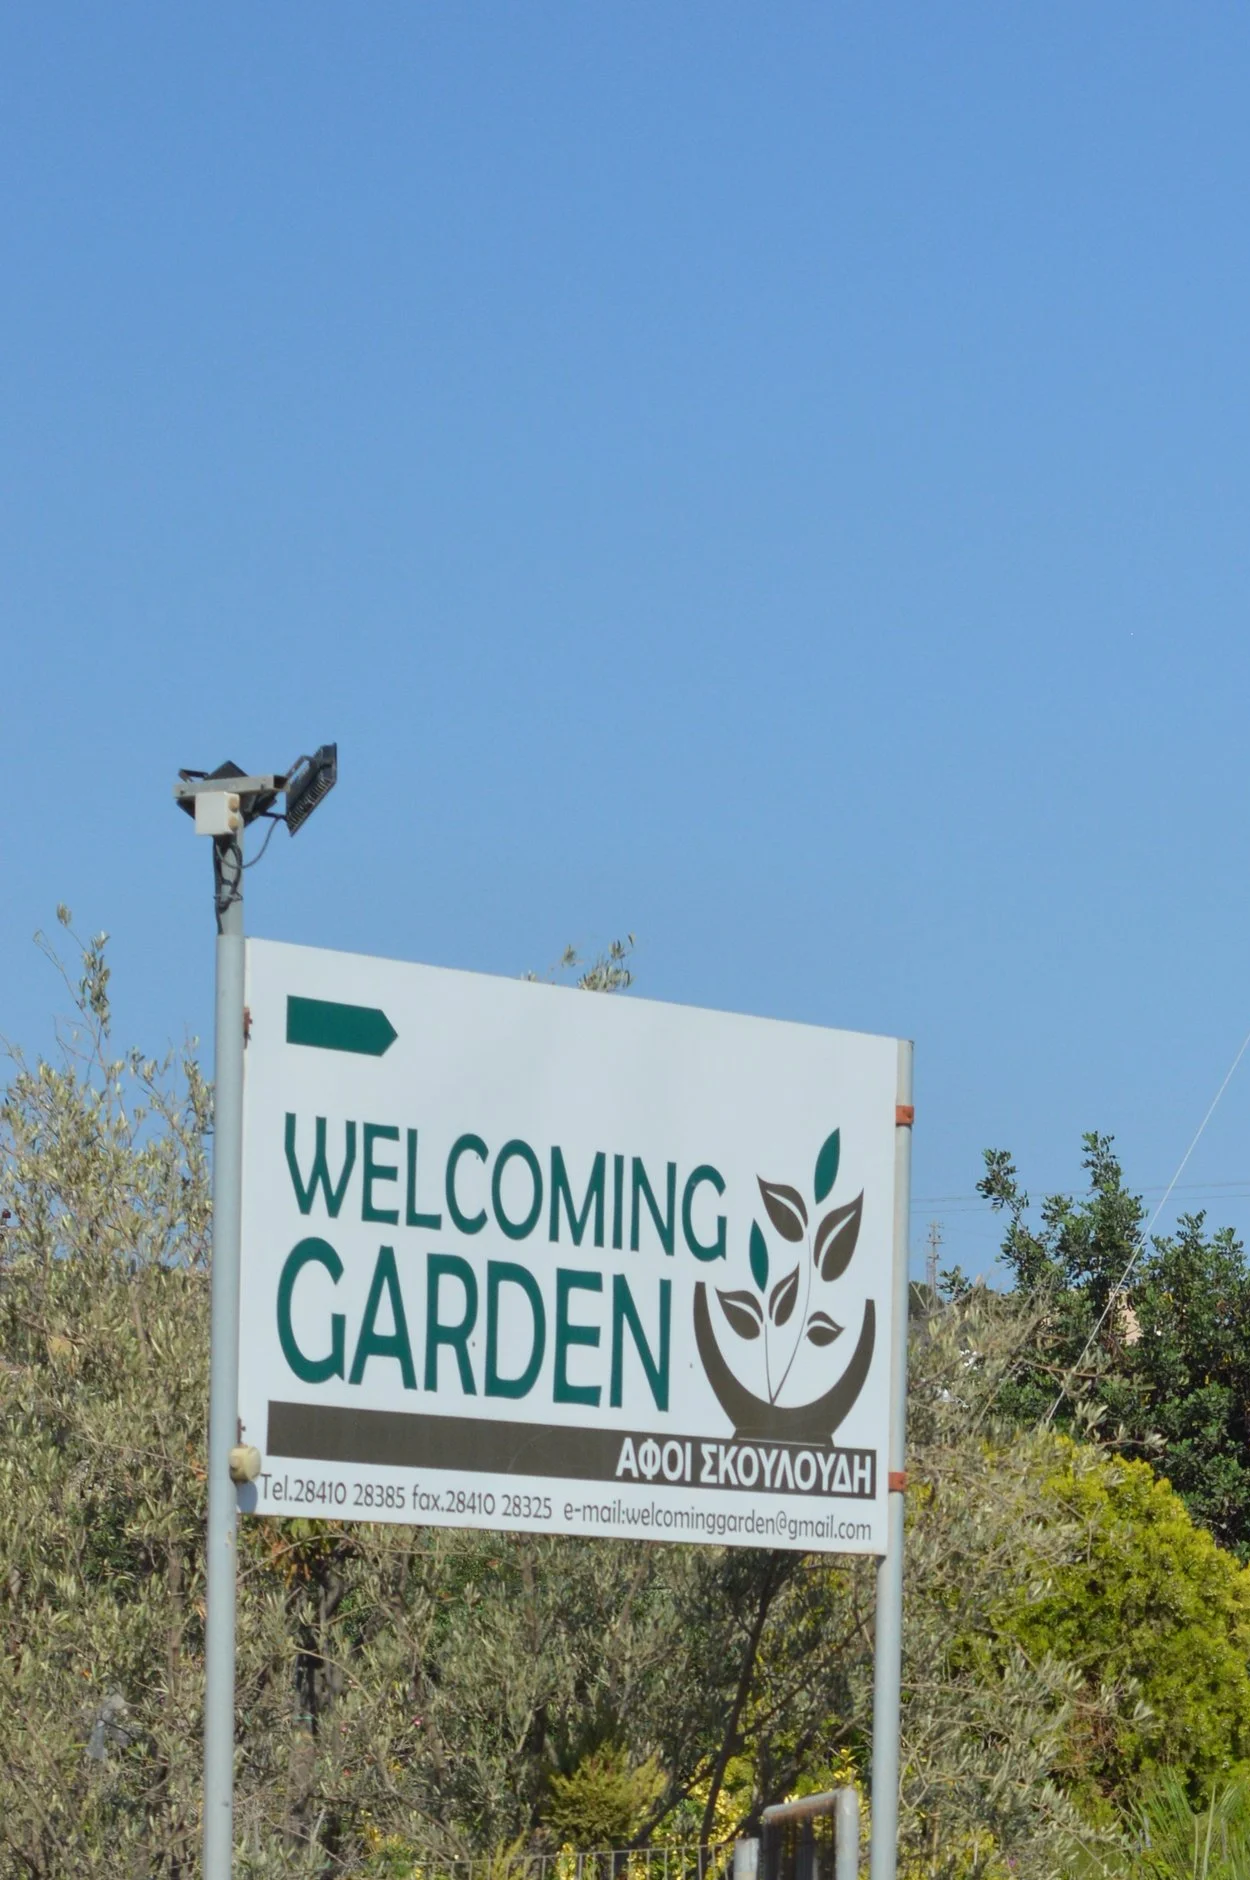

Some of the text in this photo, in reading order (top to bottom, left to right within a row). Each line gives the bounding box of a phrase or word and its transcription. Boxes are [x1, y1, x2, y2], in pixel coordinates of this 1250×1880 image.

[284, 1112, 728, 1262] WELCOMING
[277, 1236, 672, 1413] GARDEN
[261, 1473, 872, 1542] Tel.28410 28385 fax.28410 28325 e-mail:welcominggarden@gmail.com
[615, 1436, 872, 1495] ΑΦΟΙ ΣΚΟΥΛΟΥΔΗ
